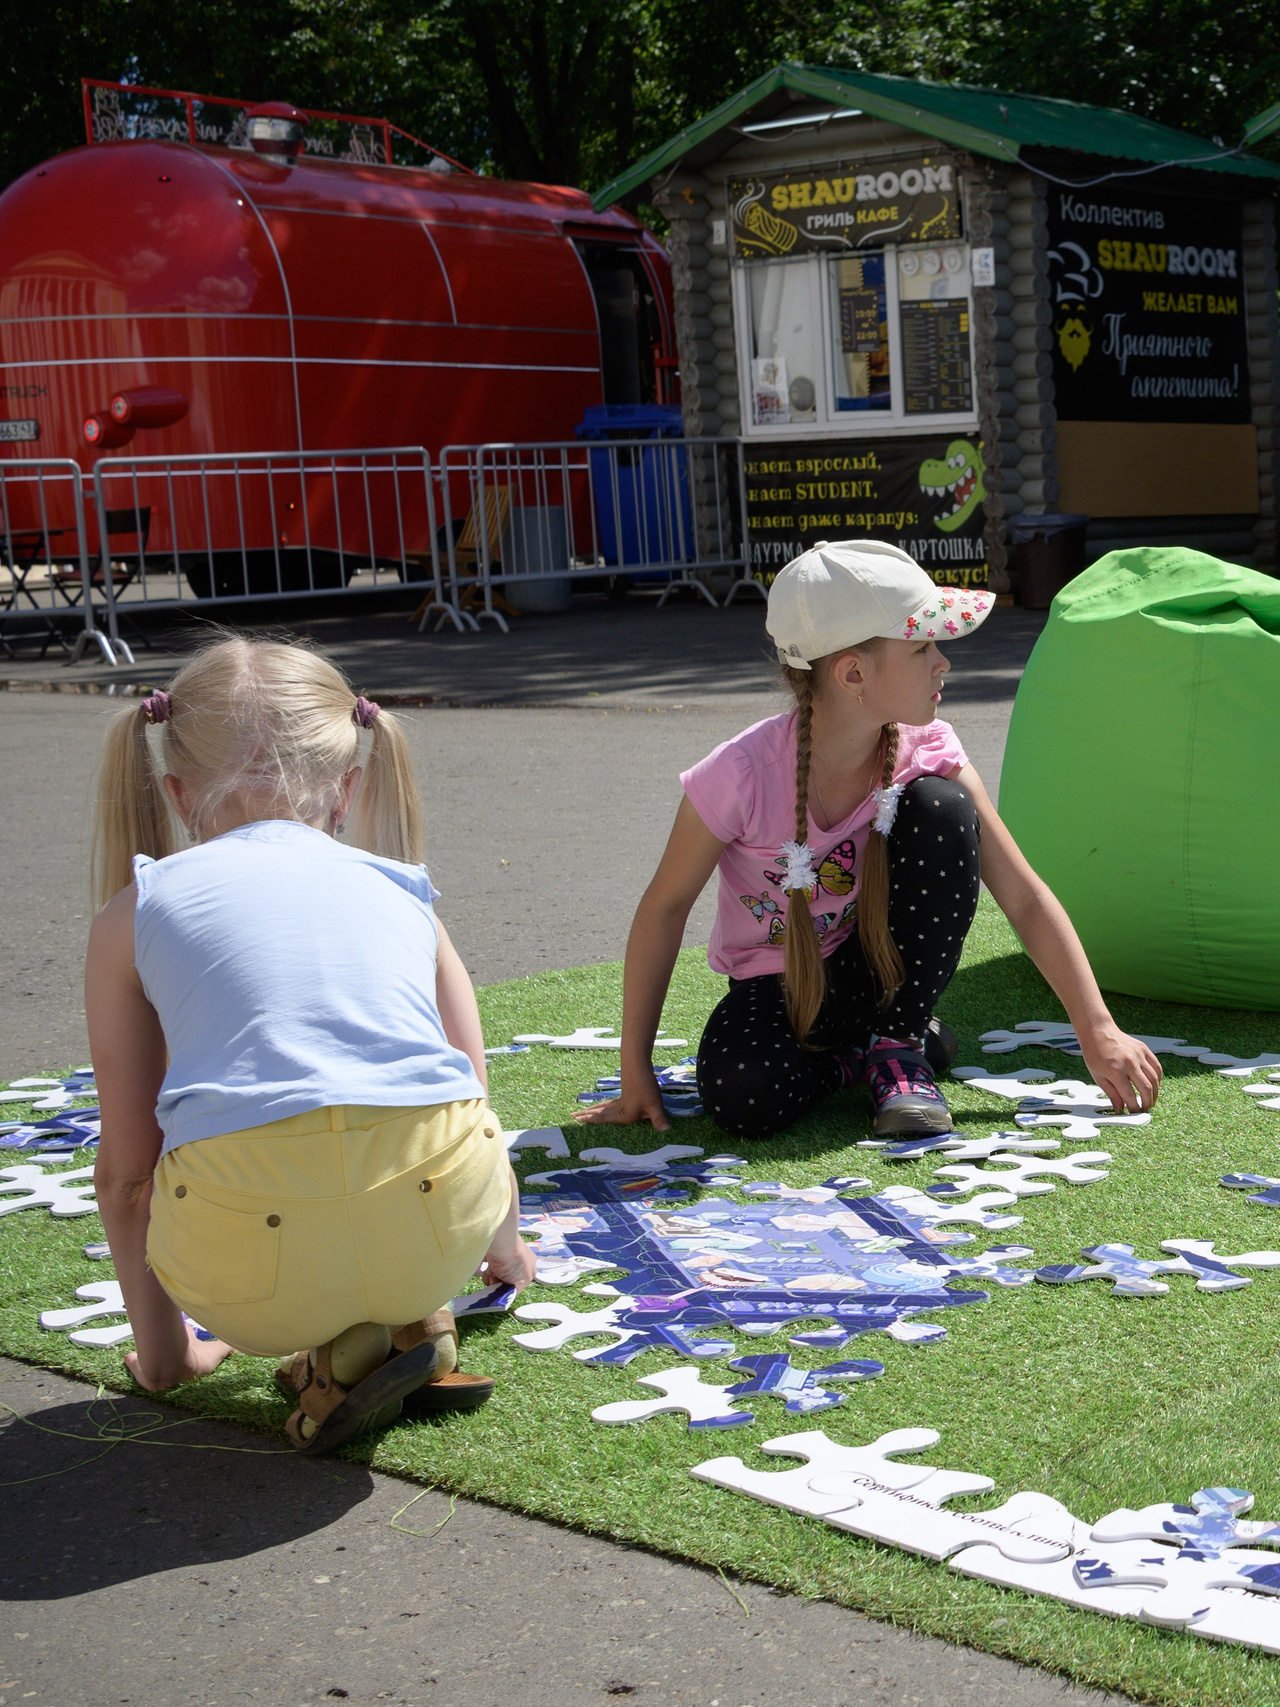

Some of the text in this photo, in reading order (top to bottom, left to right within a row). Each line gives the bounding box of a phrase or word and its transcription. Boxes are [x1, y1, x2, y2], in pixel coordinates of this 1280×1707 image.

[771, 165, 953, 212] SHAUROOM
[806, 206, 899, 230] ГРИЛЬ КАФЕ
[1060, 194, 1165, 229] Коллектив
[1097, 239, 1238, 278] SHAUROOM
[1142, 291, 1238, 315] ЖЕЛАЕТ ВАМ
[1102, 313, 1213, 375] Приятного
[0, 385, 48, 399] TRUCK
[1131, 363, 1239, 397] аппетита!
[796, 452, 882, 476] взрослый,
[746, 481, 879, 501] нает STUDENT,
[799, 513, 842, 532] даже
[846, 511, 919, 531] карапуз:
